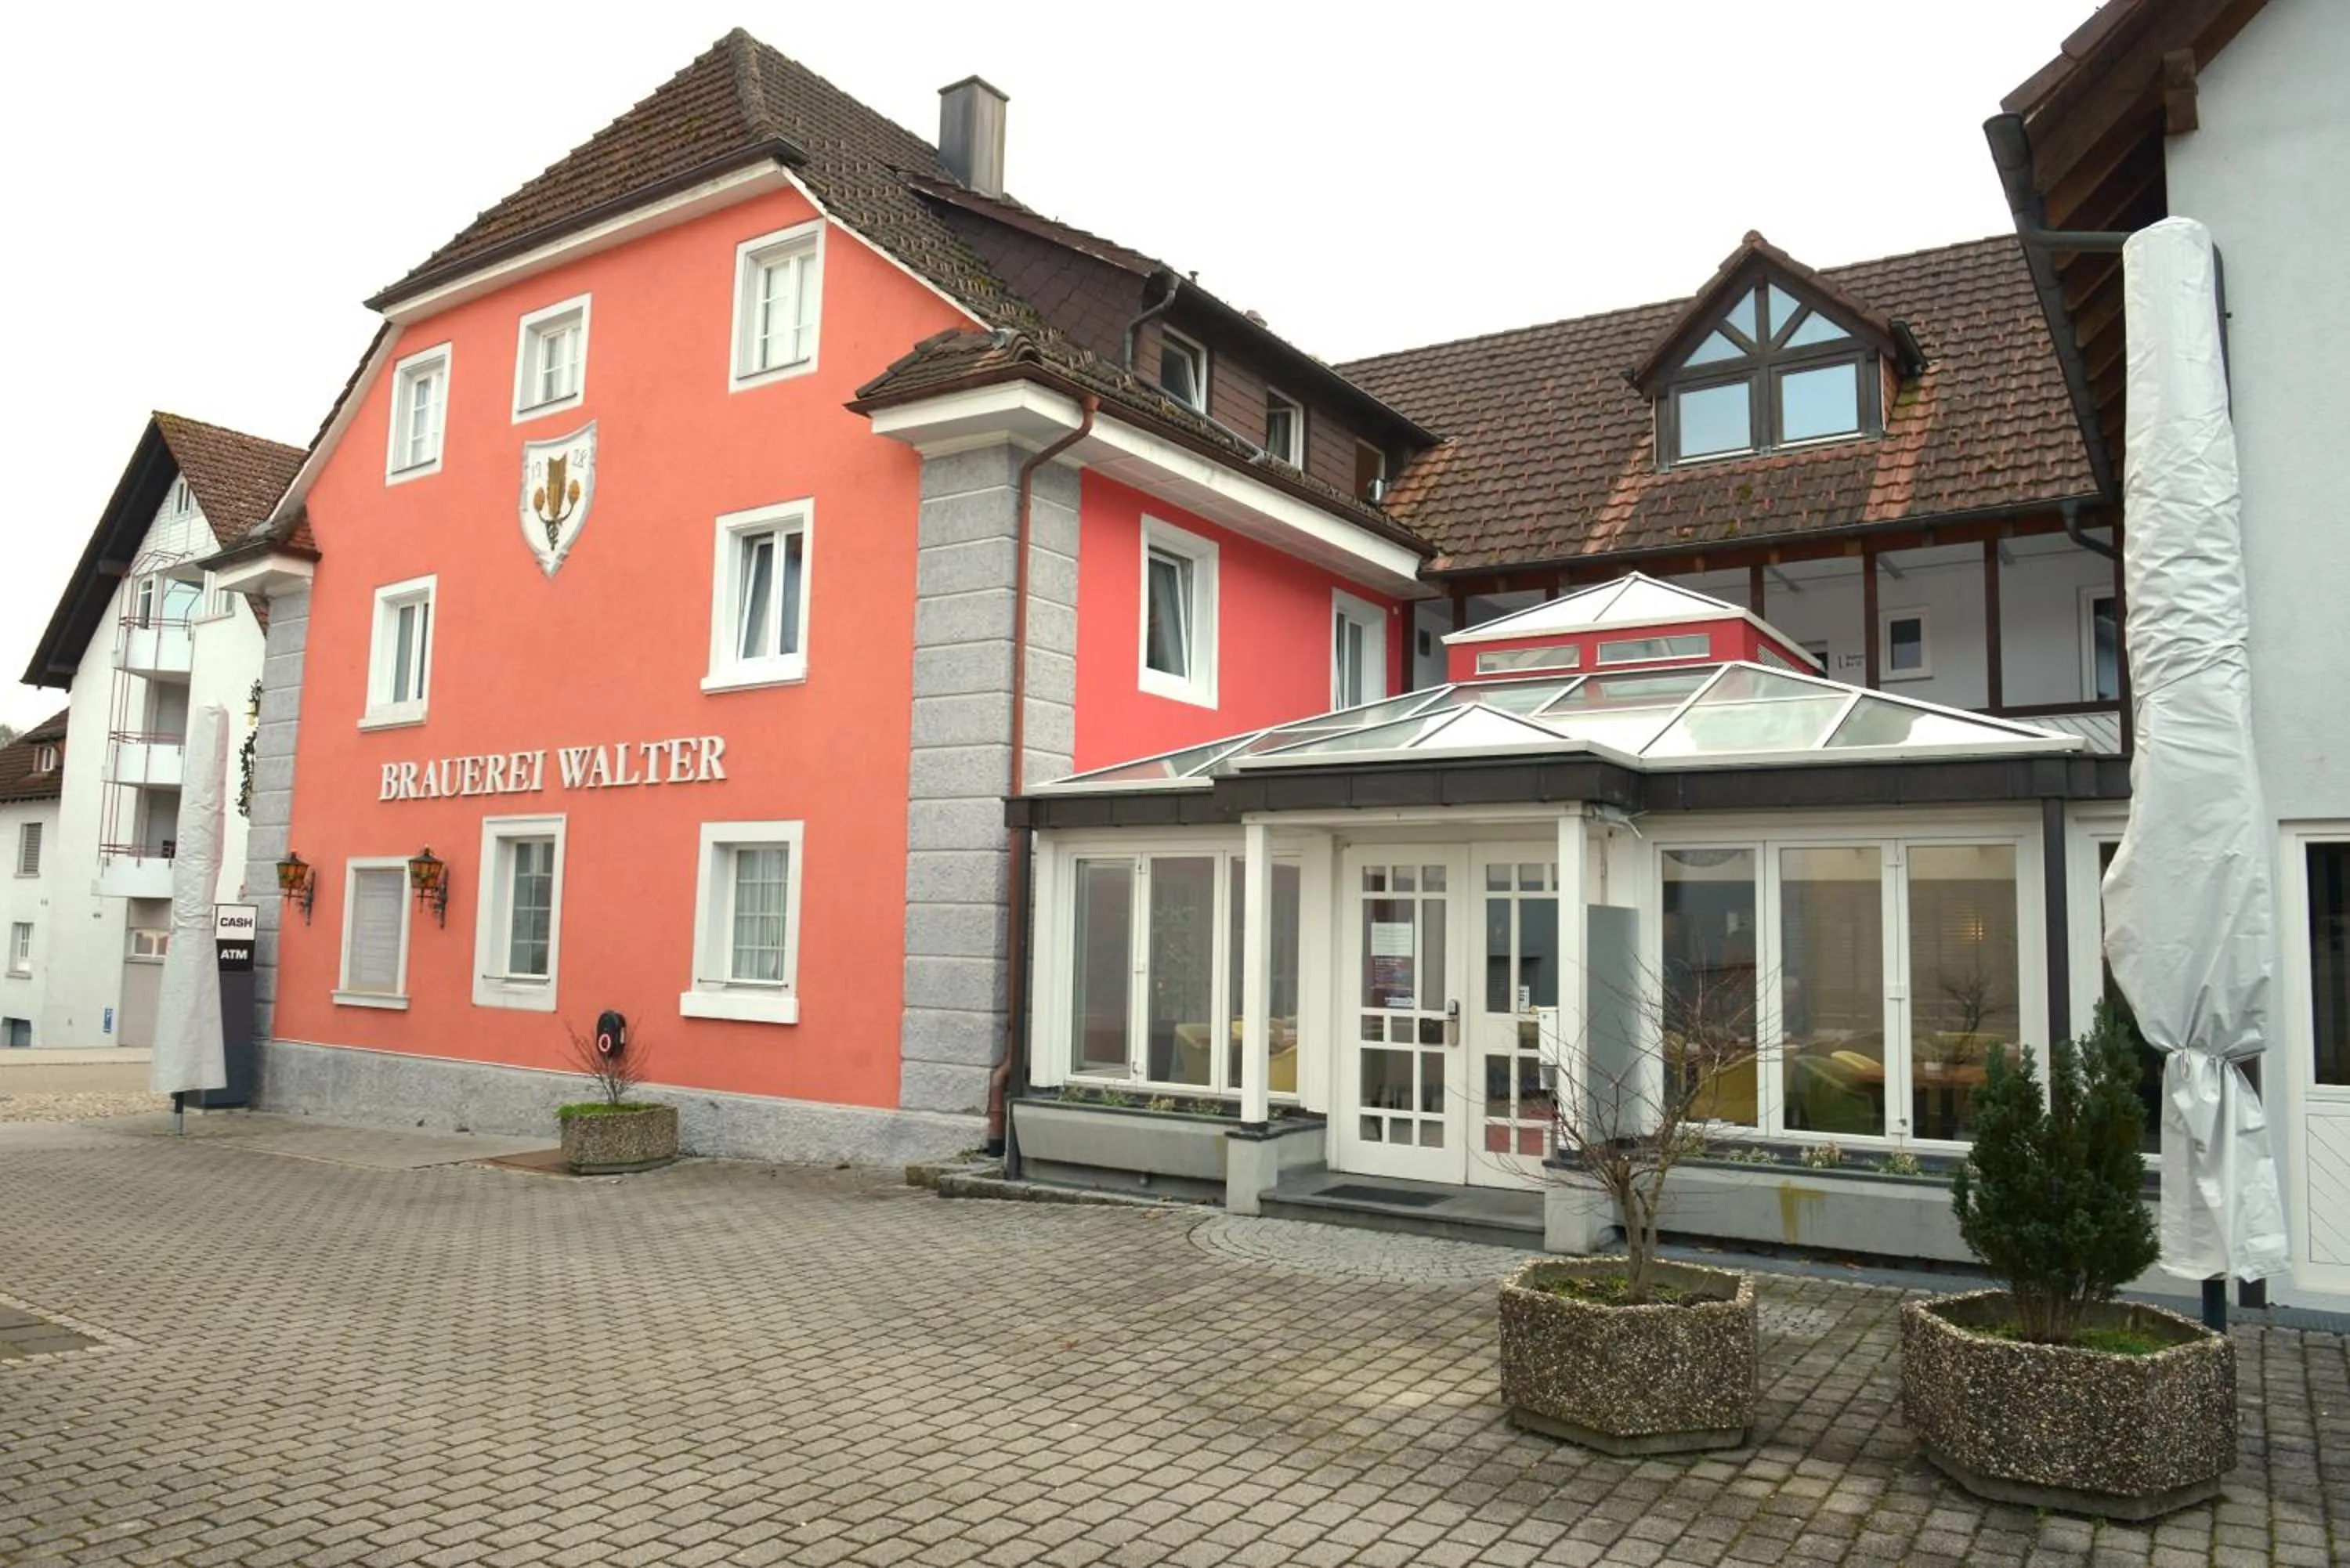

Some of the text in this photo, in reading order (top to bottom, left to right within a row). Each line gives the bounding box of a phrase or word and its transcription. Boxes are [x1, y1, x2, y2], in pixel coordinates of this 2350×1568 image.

[378, 735, 727, 801] BRAUEREI WALTER
[220, 917, 253, 928] CASH
[220, 948, 248, 960] ATM
